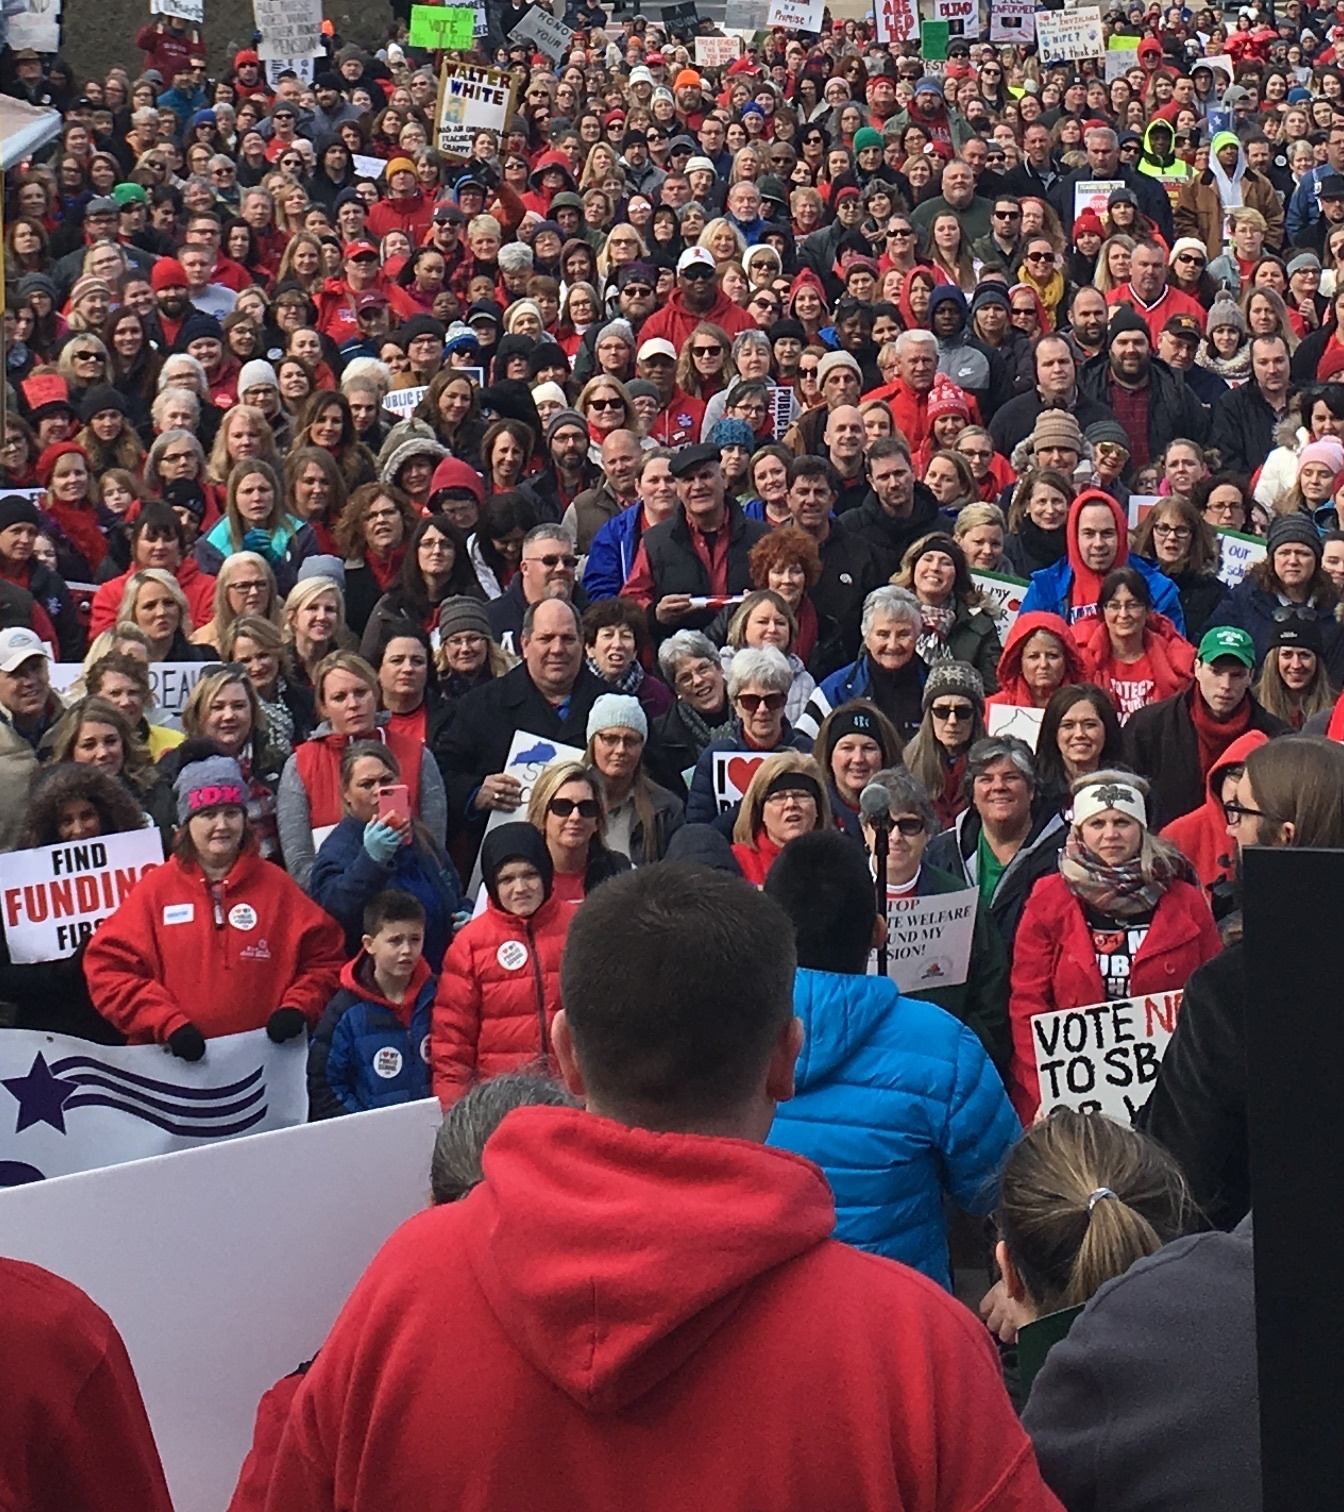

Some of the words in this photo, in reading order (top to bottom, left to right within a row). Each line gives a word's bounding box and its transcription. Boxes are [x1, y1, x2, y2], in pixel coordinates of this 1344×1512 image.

[939, 1, 973, 17] BLIND
[991, 5, 1035, 15] INFORMED
[428, 18, 458, 34] VOTE
[885, 14, 915, 31] LED
[889, 29, 910, 43] BY
[446, 63, 512, 89] WALTER
[450, 79, 505, 106] WHITE
[777, 389, 791, 427] PUBLIC
[1228, 545, 1252, 560] our
[1226, 564, 1246, 578] sch
[990, 586, 1011, 606] my
[717, 756, 726, 795] I
[188, 784, 244, 810] IDK
[51, 842, 108, 876] FIND
[887, 898, 920, 913] TOP
[907, 904, 972, 927] WELFARE
[887, 930, 918, 945] UND
[921, 925, 945, 940] MY
[1034, 1002, 1136, 1057] VOTE
[1040, 1055, 1096, 1099] TO
[1104, 1042, 1161, 1087] SB
